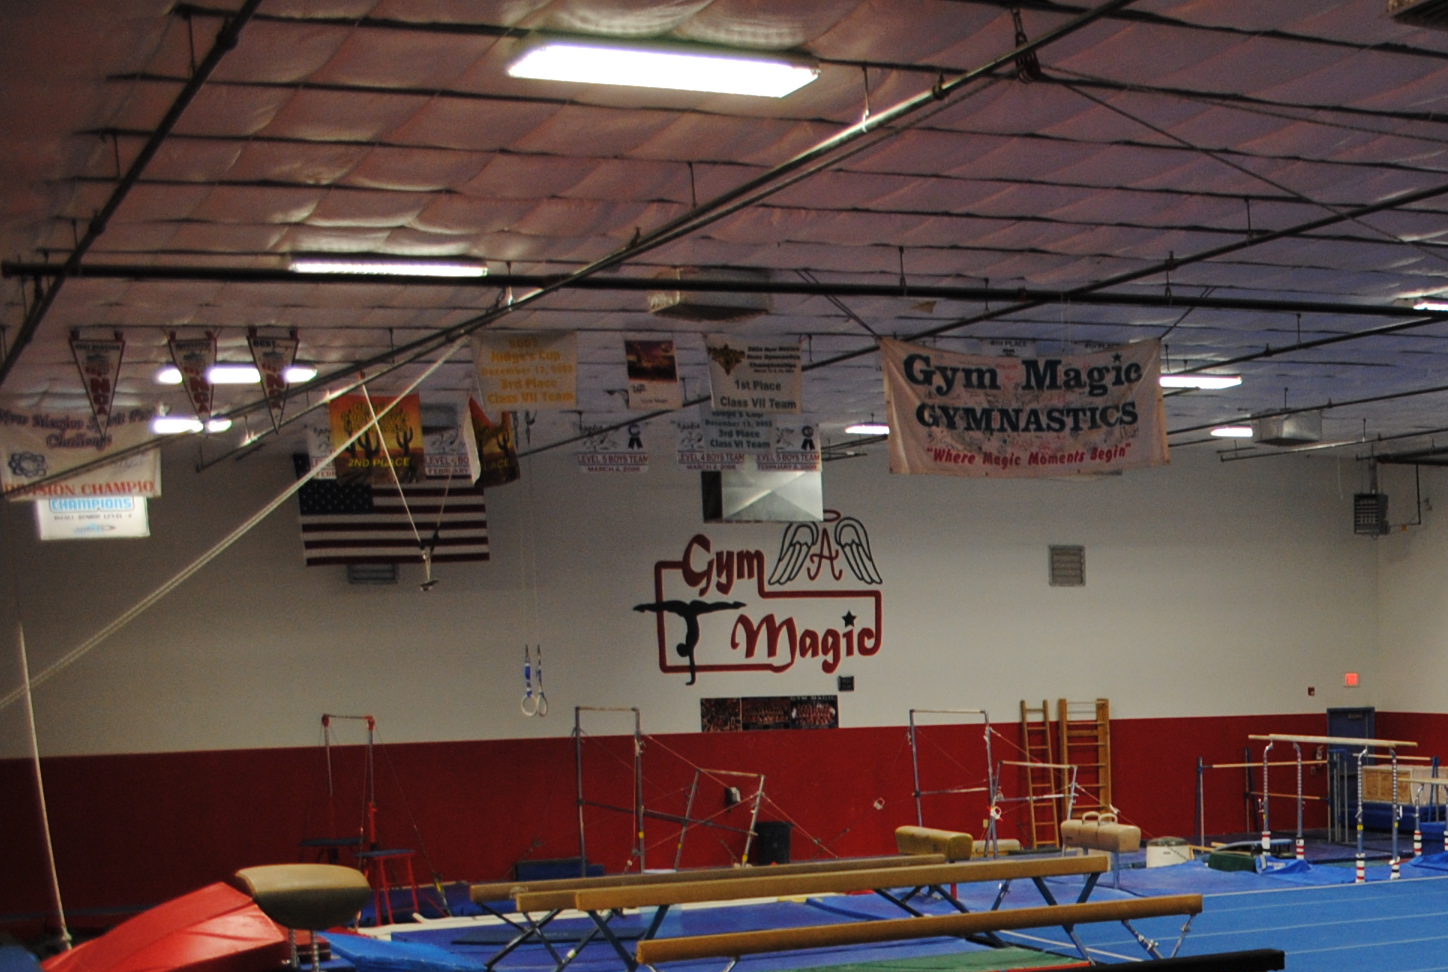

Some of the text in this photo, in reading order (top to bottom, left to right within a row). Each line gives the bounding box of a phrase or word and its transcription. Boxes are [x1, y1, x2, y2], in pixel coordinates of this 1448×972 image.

[538, 350, 561, 362] Cup
[764, 354, 801, 362] Gymnastics
[749, 362, 797, 370] Championships
[481, 367, 530, 376] December
[903, 353, 1143, 397] Gym Magic
[500, 378, 558, 390] 3rd Place
[735, 379, 782, 391] 1st Place
[487, 393, 519, 404] Class
[543, 391, 576, 403] Team
[720, 396, 748, 408] Class
[768, 398, 796, 409] Team
[915, 401, 1139, 433] GYMNASTICS
[705, 419, 740, 427] December
[718, 429, 760, 438] 3rd Place
[710, 440, 732, 448] Class
[746, 440, 770, 449] Team
[608, 455, 628, 463] BOYS
[679, 453, 698, 462] EVEL
[725, 453, 745, 462] TEAM
[756, 453, 775, 462] EVEL
[801, 453, 820, 462] TEAM
[926, 442, 1132, 471] "Where Magic Moments Begin"
[348, 458, 370, 467] 2ND
[682, 533, 766, 597] Gym
[730, 609, 882, 674] Magic
